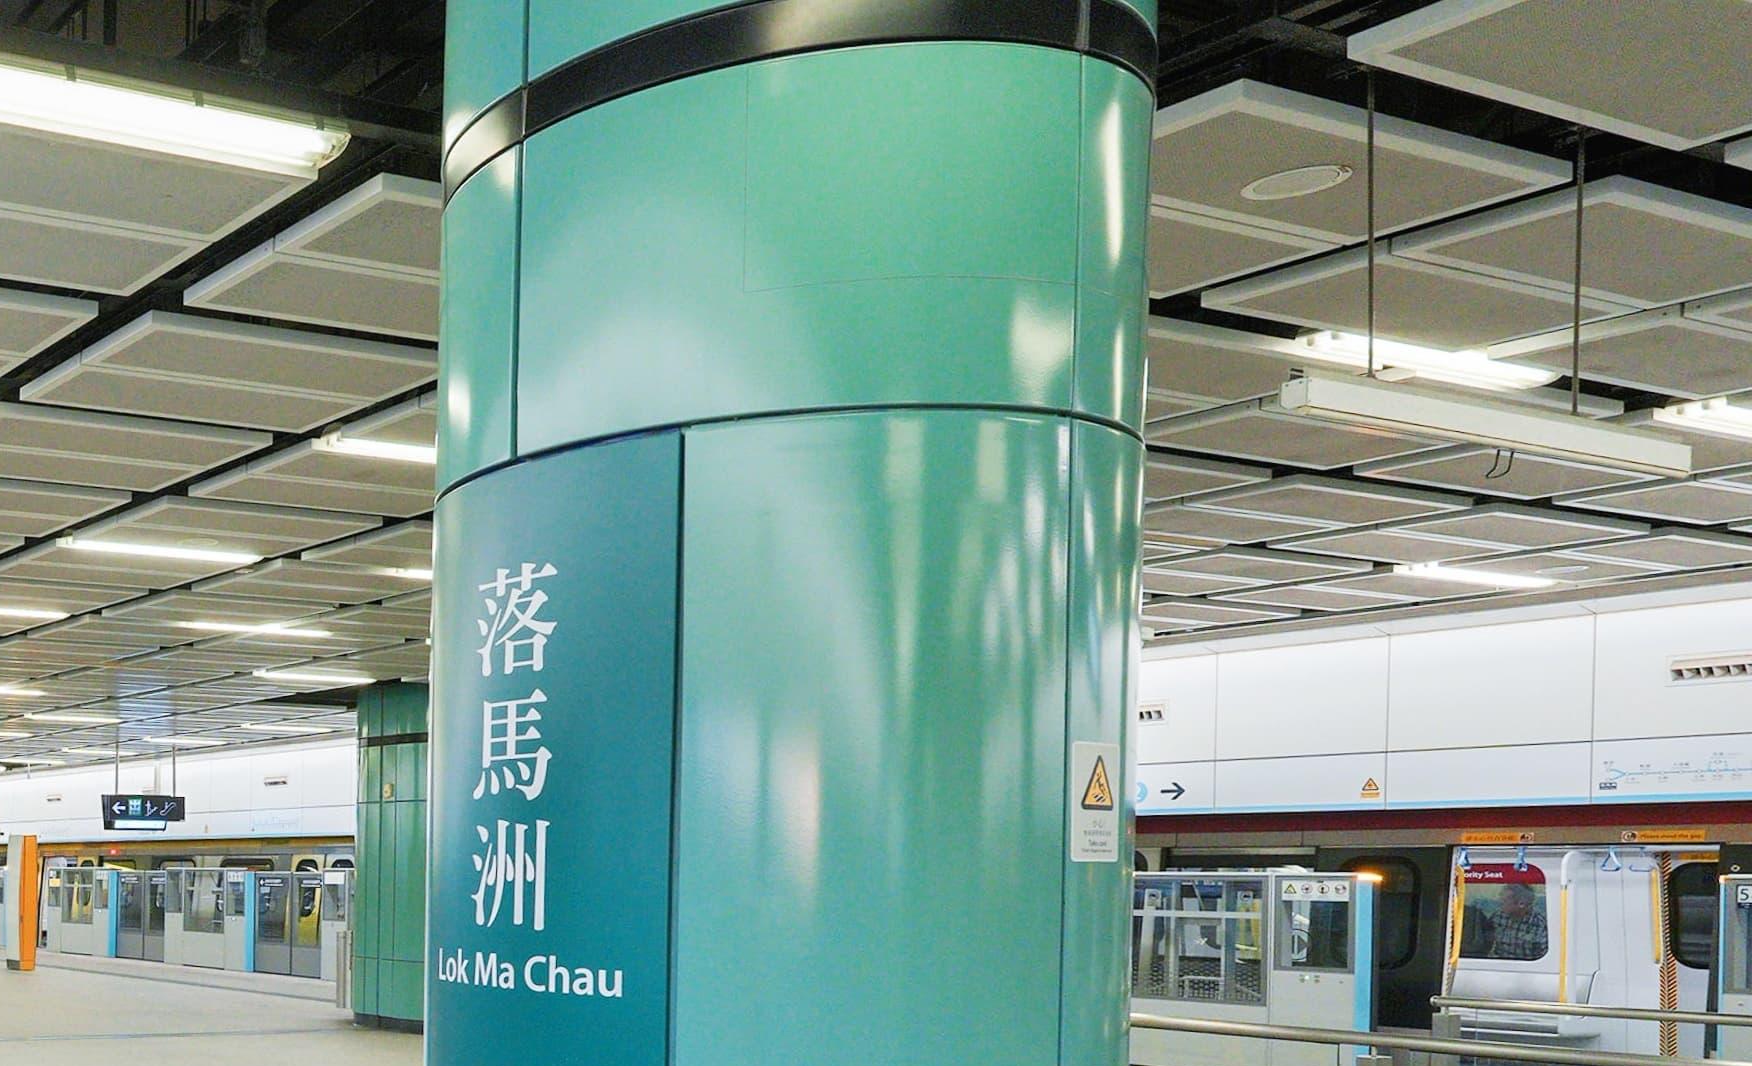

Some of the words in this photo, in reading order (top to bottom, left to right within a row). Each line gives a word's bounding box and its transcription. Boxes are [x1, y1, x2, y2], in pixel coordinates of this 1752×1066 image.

[470, 562, 558, 931] 落馬洲
[438, 947, 469, 985] Lok
[474, 951, 515, 990] Ma
[524, 954, 623, 998] Chau
